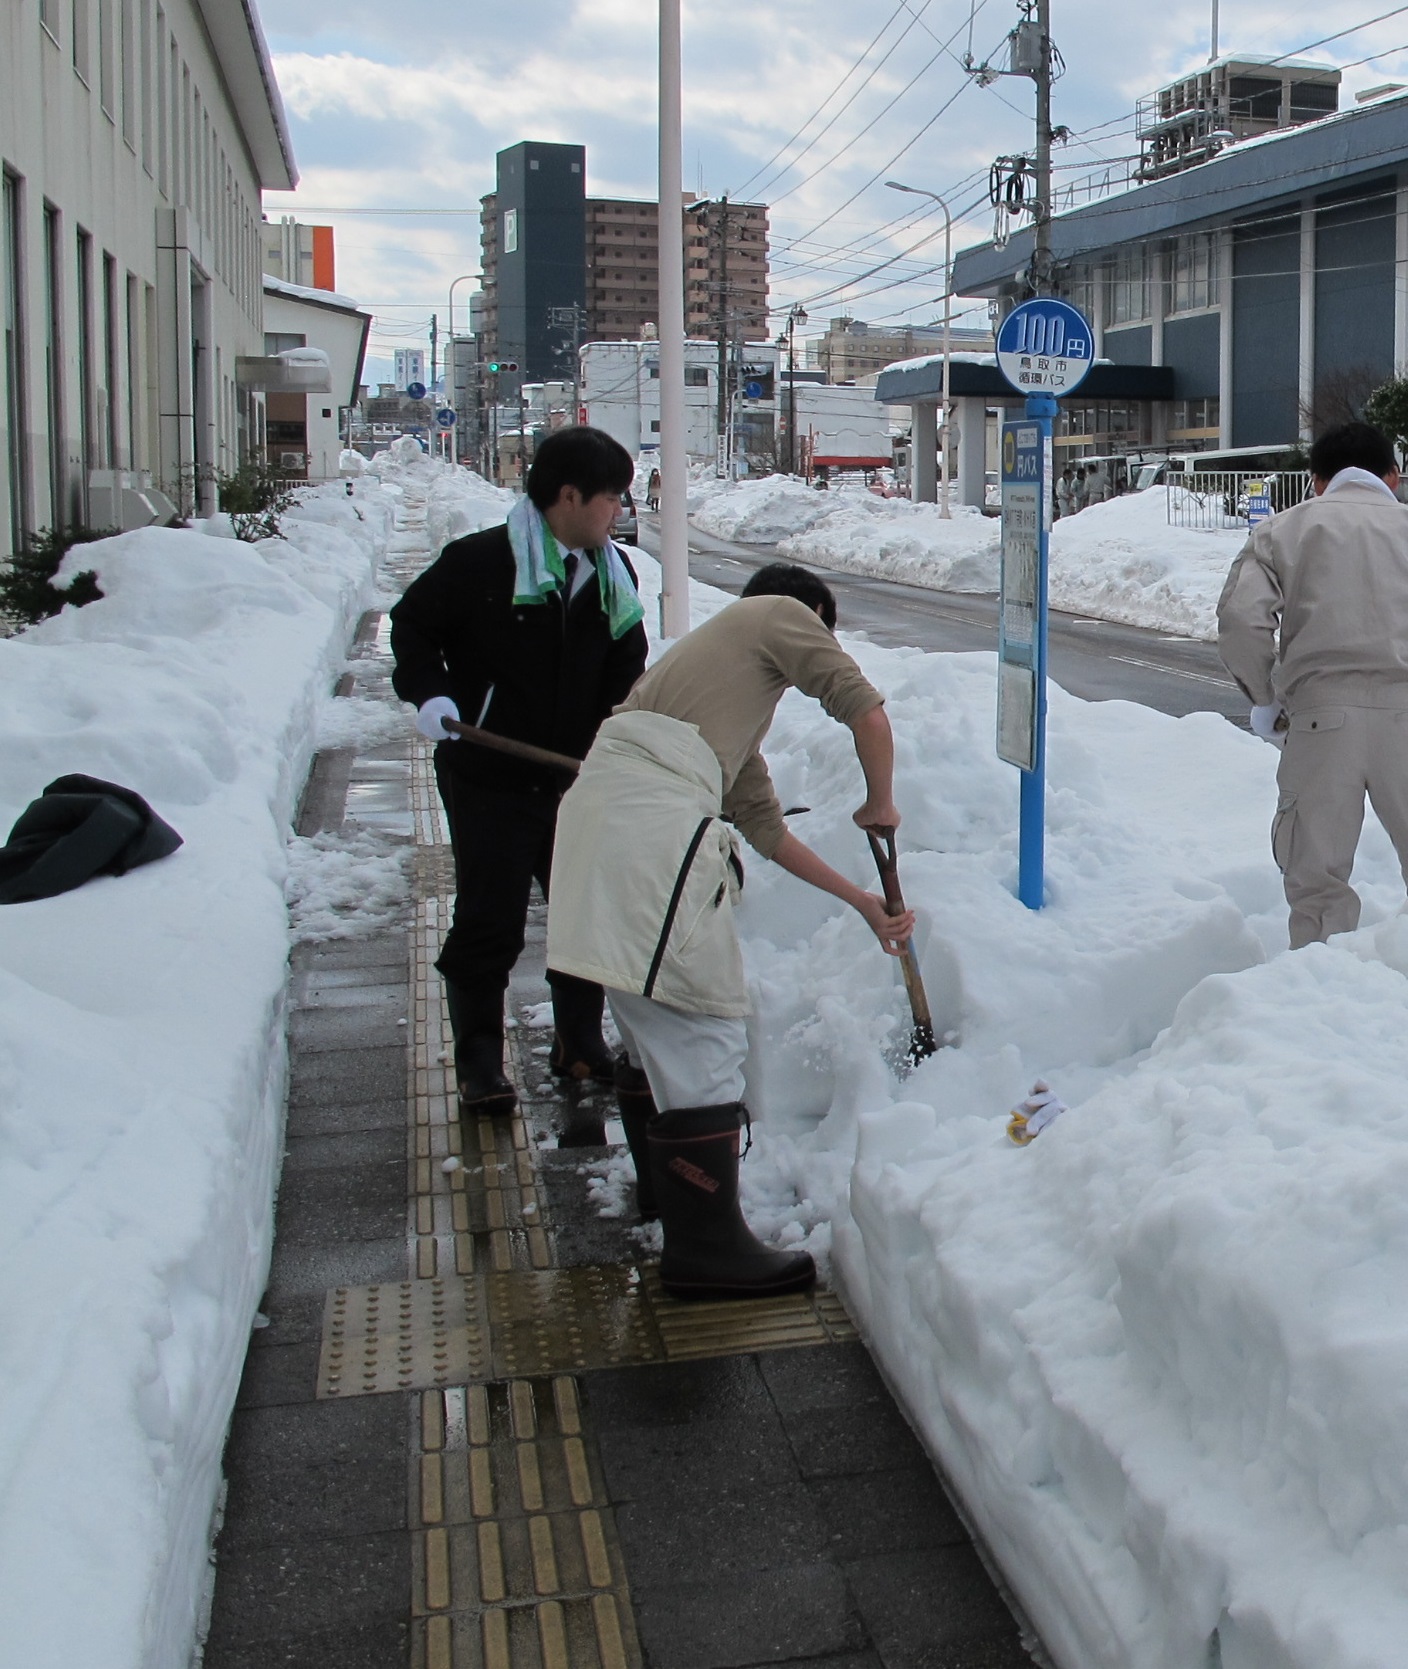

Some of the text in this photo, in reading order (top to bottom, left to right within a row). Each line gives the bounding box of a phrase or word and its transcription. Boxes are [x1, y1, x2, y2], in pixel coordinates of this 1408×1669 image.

[1014, 312, 1086, 358] 100円
[1020, 357, 1068, 372] 鳥取市
[1019, 372, 1066, 387] 循環バス
[1017, 454, 1038, 478] 円バス
